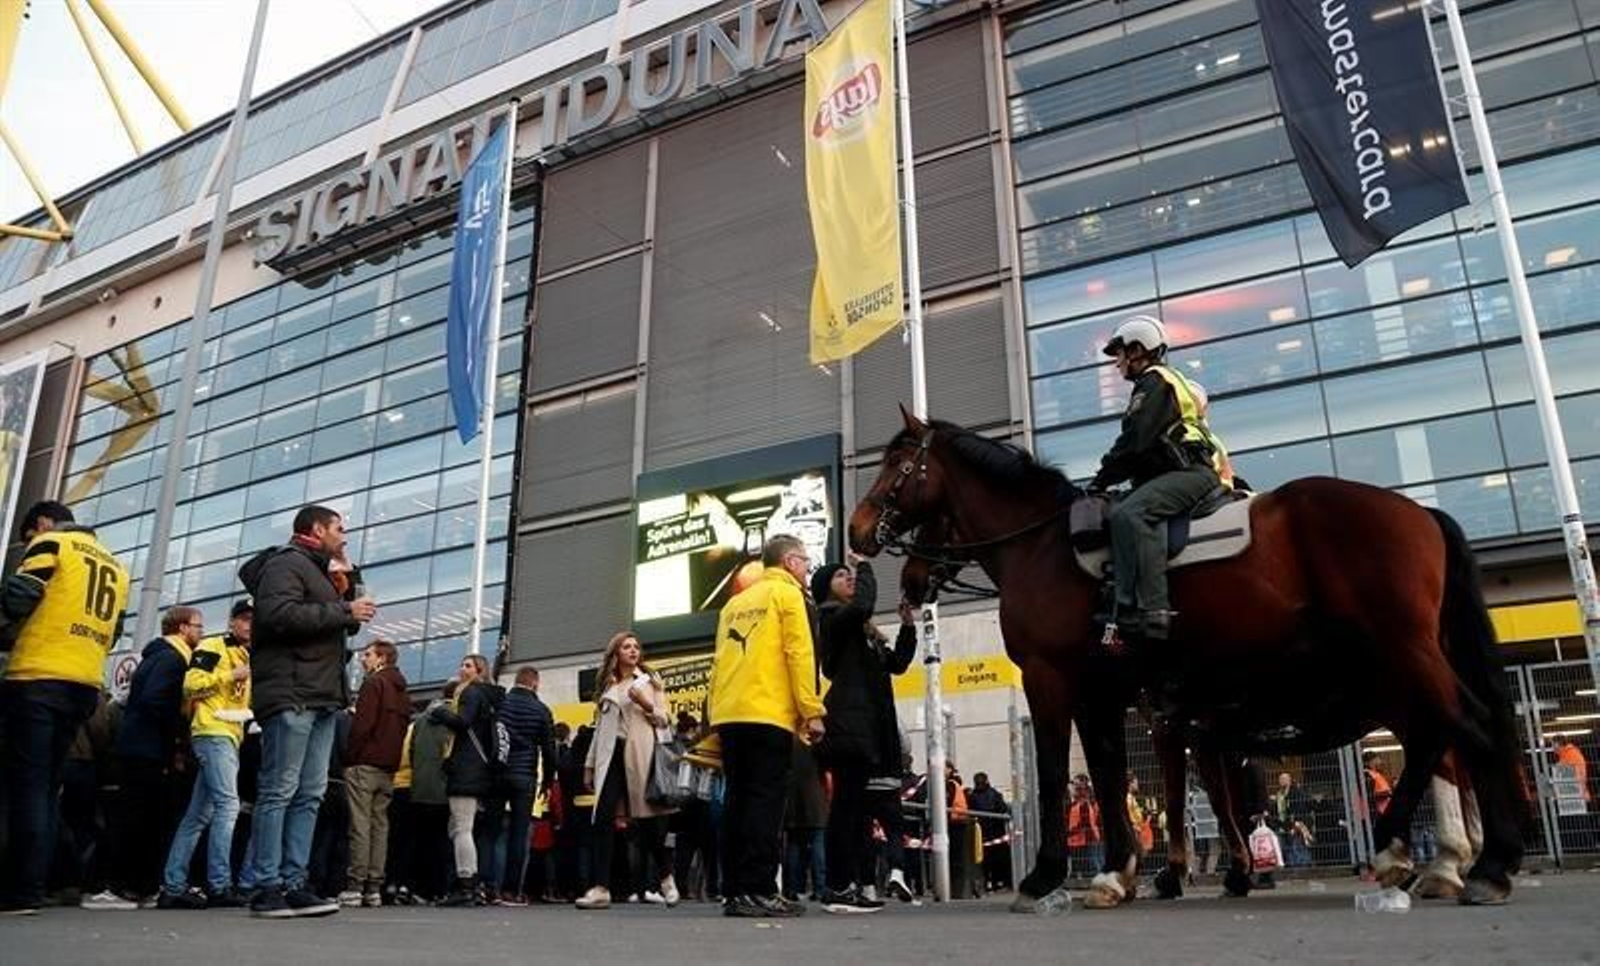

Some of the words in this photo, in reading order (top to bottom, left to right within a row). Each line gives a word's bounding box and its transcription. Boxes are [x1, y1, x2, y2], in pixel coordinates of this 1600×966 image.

[541, 0, 830, 150] IDUNA
[84, 557, 117, 622] 16
[957, 672, 997, 685] Eingang
[967, 662, 984, 673] VIP
